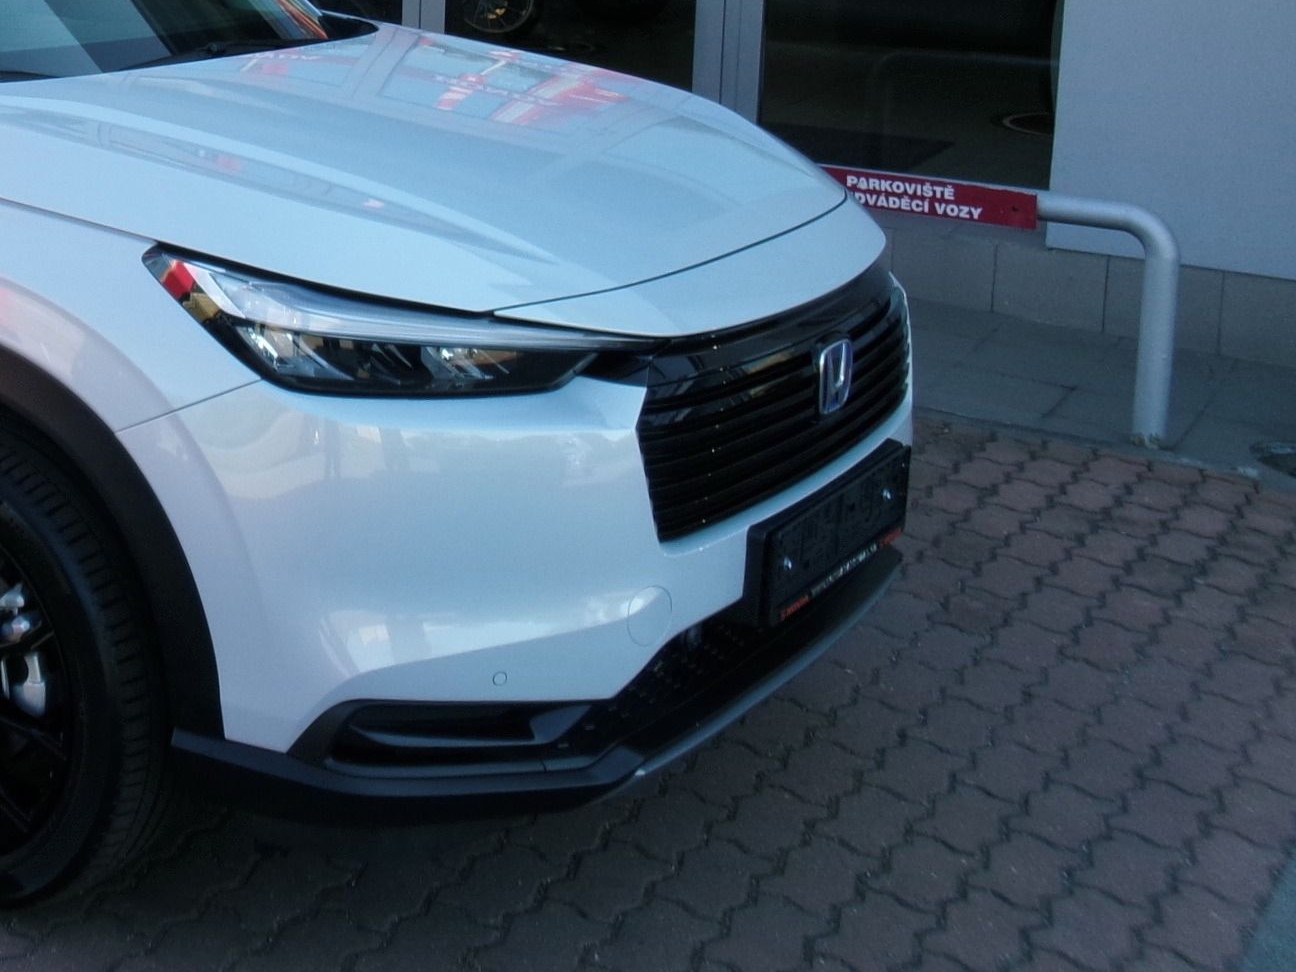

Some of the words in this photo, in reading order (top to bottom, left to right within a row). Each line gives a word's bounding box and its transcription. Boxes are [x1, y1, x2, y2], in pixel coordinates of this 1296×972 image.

[845, 174, 955, 201] PARKOVIŠTĚ
[851, 191, 930, 214] DVÁDĚCÍ
[935, 201, 983, 220] VOZY
